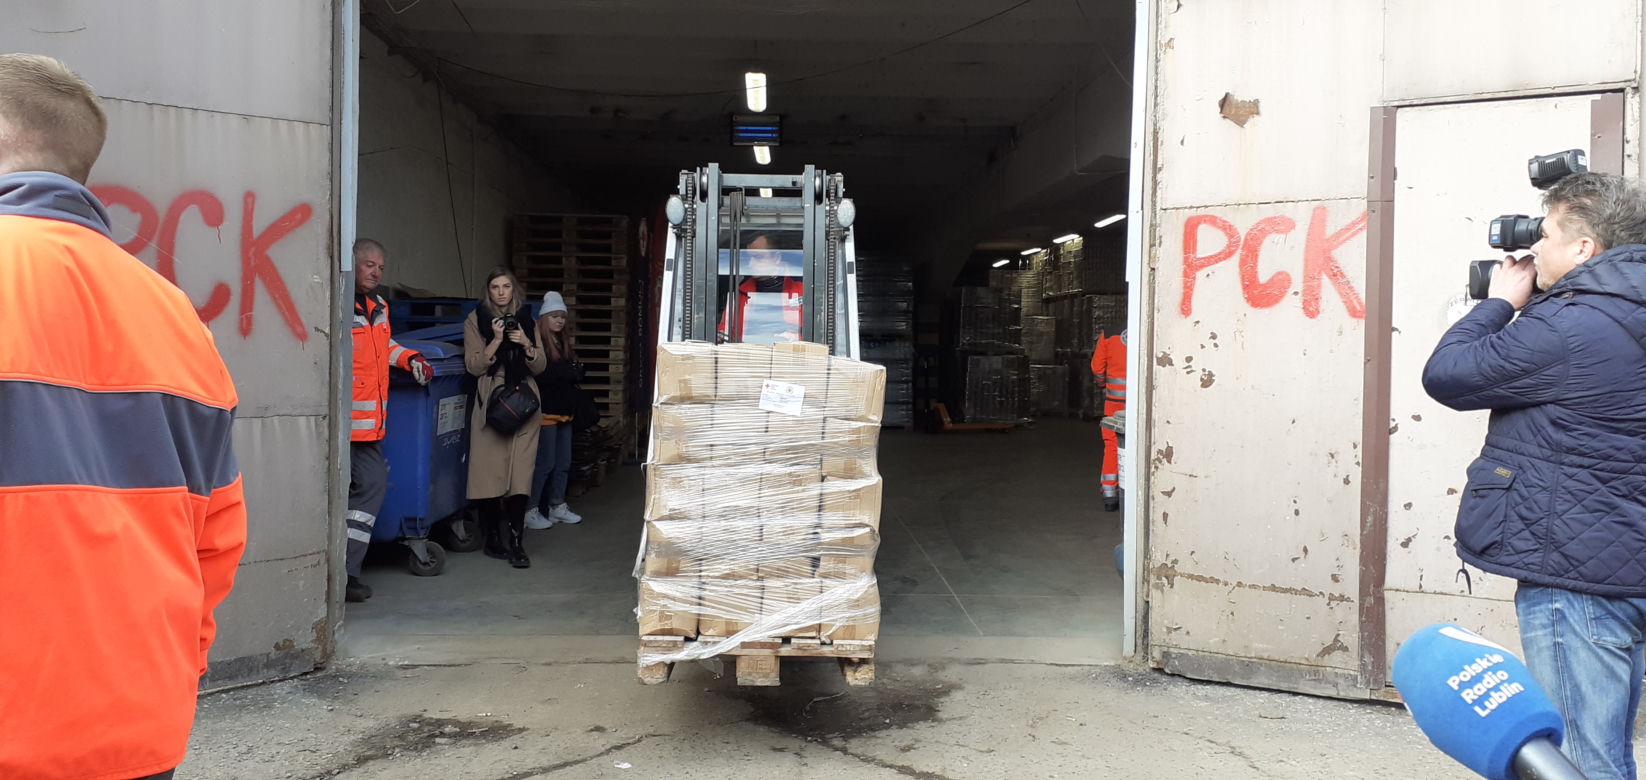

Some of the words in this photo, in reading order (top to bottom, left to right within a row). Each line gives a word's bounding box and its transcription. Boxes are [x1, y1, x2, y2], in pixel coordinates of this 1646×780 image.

[1180, 205, 1368, 319] PCK
[1447, 654, 1504, 690] Polskie
[1460, 670, 1509, 704] Radio
[1473, 682, 1525, 717] Lublin
